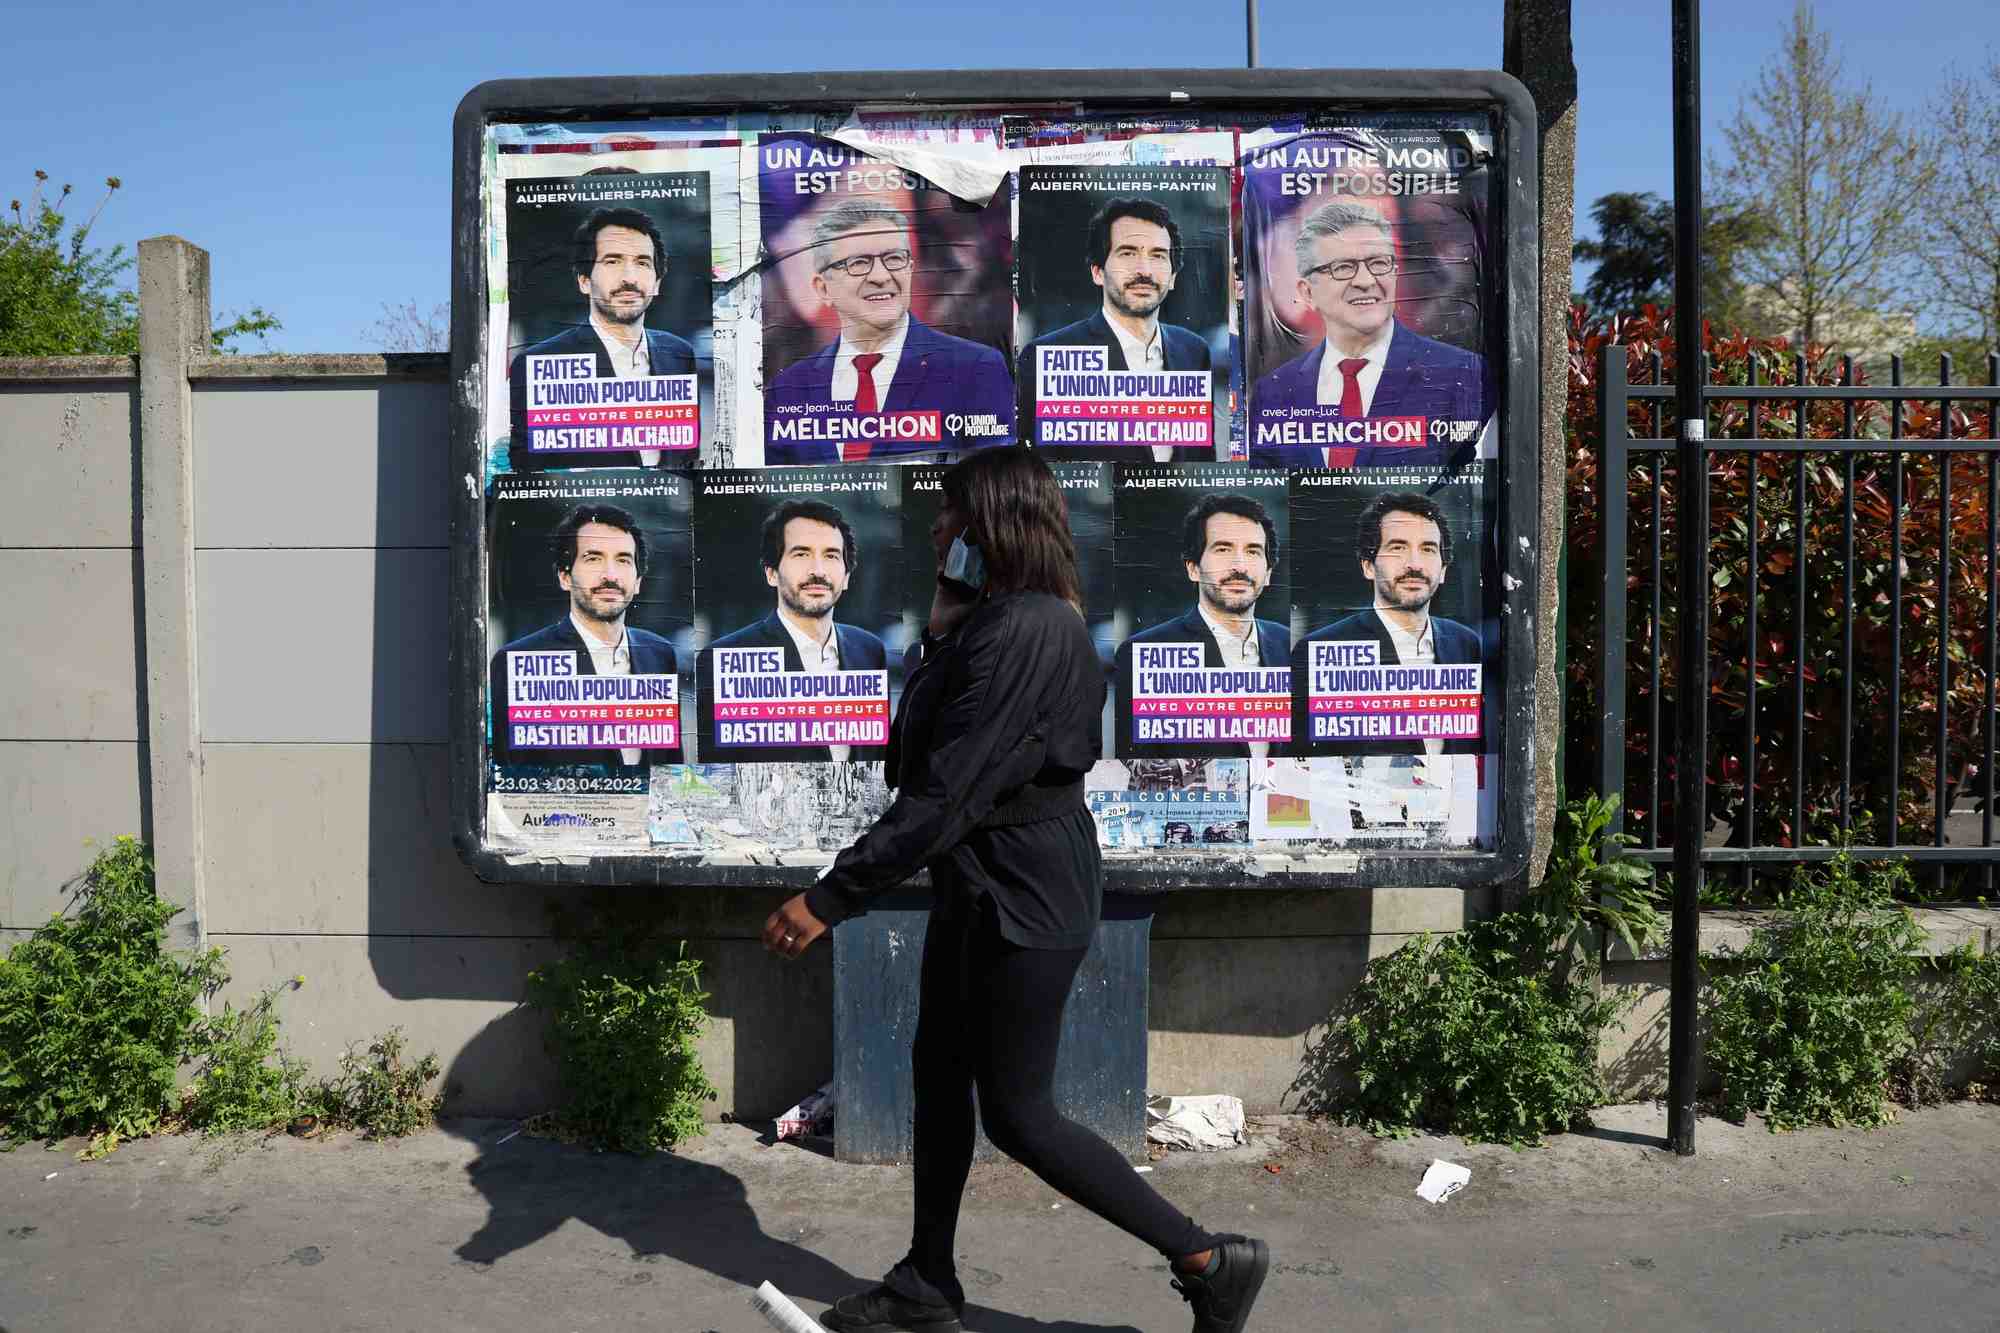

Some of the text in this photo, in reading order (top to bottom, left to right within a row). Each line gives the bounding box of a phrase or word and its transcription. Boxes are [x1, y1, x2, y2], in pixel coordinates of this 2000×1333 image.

[766, 148, 801, 169] UN
[1252, 147, 1287, 169] UN
[1294, 147, 1380, 168] AUTRE
[795, 171, 840, 194] EST
[1030, 181, 1216, 192] AUBERVILLIERS-PANTIN
[1281, 172, 1460, 196] EST POSSIBLE
[516, 187, 697, 204] AUBERVILLIERS-PANTIN
[533, 358, 592, 380] FAITES
[1043, 350, 1104, 371] FAITES
[533, 379, 693, 406] L'UNION POPULAIRE
[1043, 375, 1206, 397] L'UNION POPULAIRE
[532, 408, 694, 423] AVEC VOTRE DÉPUTÉ
[777, 402, 854, 415] avec Jean-Luc
[1042, 403, 1207, 415] AVEC VOTRE DÉPUTÉ
[1262, 405, 1339, 419] avec Jean-Luc
[532, 425, 694, 450] BASTIEN LACHAUD
[965, 424, 1009, 437] POPULAIRE
[1042, 420, 1207, 442] BASTIEN LACHAUD
[703, 480, 887, 495] AUBERVILLIERS-PANTIN
[1124, 477, 1290, 488] AUBERVILLIERS-PAN
[1300, 475, 1485, 487] AUBERVILLIERS-PANTIN
[498, 486, 680, 500] AUBERVILLIERS-PANTIN
[514, 655, 572, 677] FAITES
[720, 651, 780, 673] FAITES
[1139, 647, 1200, 669] FAITES
[1315, 645, 1376, 667] FAITES
[514, 678, 673, 701] L'UNION POPULAIRE
[720, 675, 882, 699] L'UNION POPULAIRE
[1139, 672, 1206, 694] L'UNION
[1315, 668, 1477, 692] L'UNION POPULAIRE
[514, 707, 674, 719] AVEC VOTRE DÉPUTÉ
[720, 703, 884, 716] AVEC VOTRE DÉPUTÉ
[1139, 702, 1178, 711] AVEC
[1186, 702, 1235, 711] VOTRE
[1315, 697, 1478, 709] AVEC VOTRE DÉPUTÉ
[514, 724, 675, 746] BASTIEN LACHAUD
[720, 720, 884, 744] BASTIEN LACHAUD
[1139, 718, 1216, 739] BASTIEN
[1315, 714, 1479, 737] BASTIEN LACHAUD
[1097, 792, 1121, 802] EN
